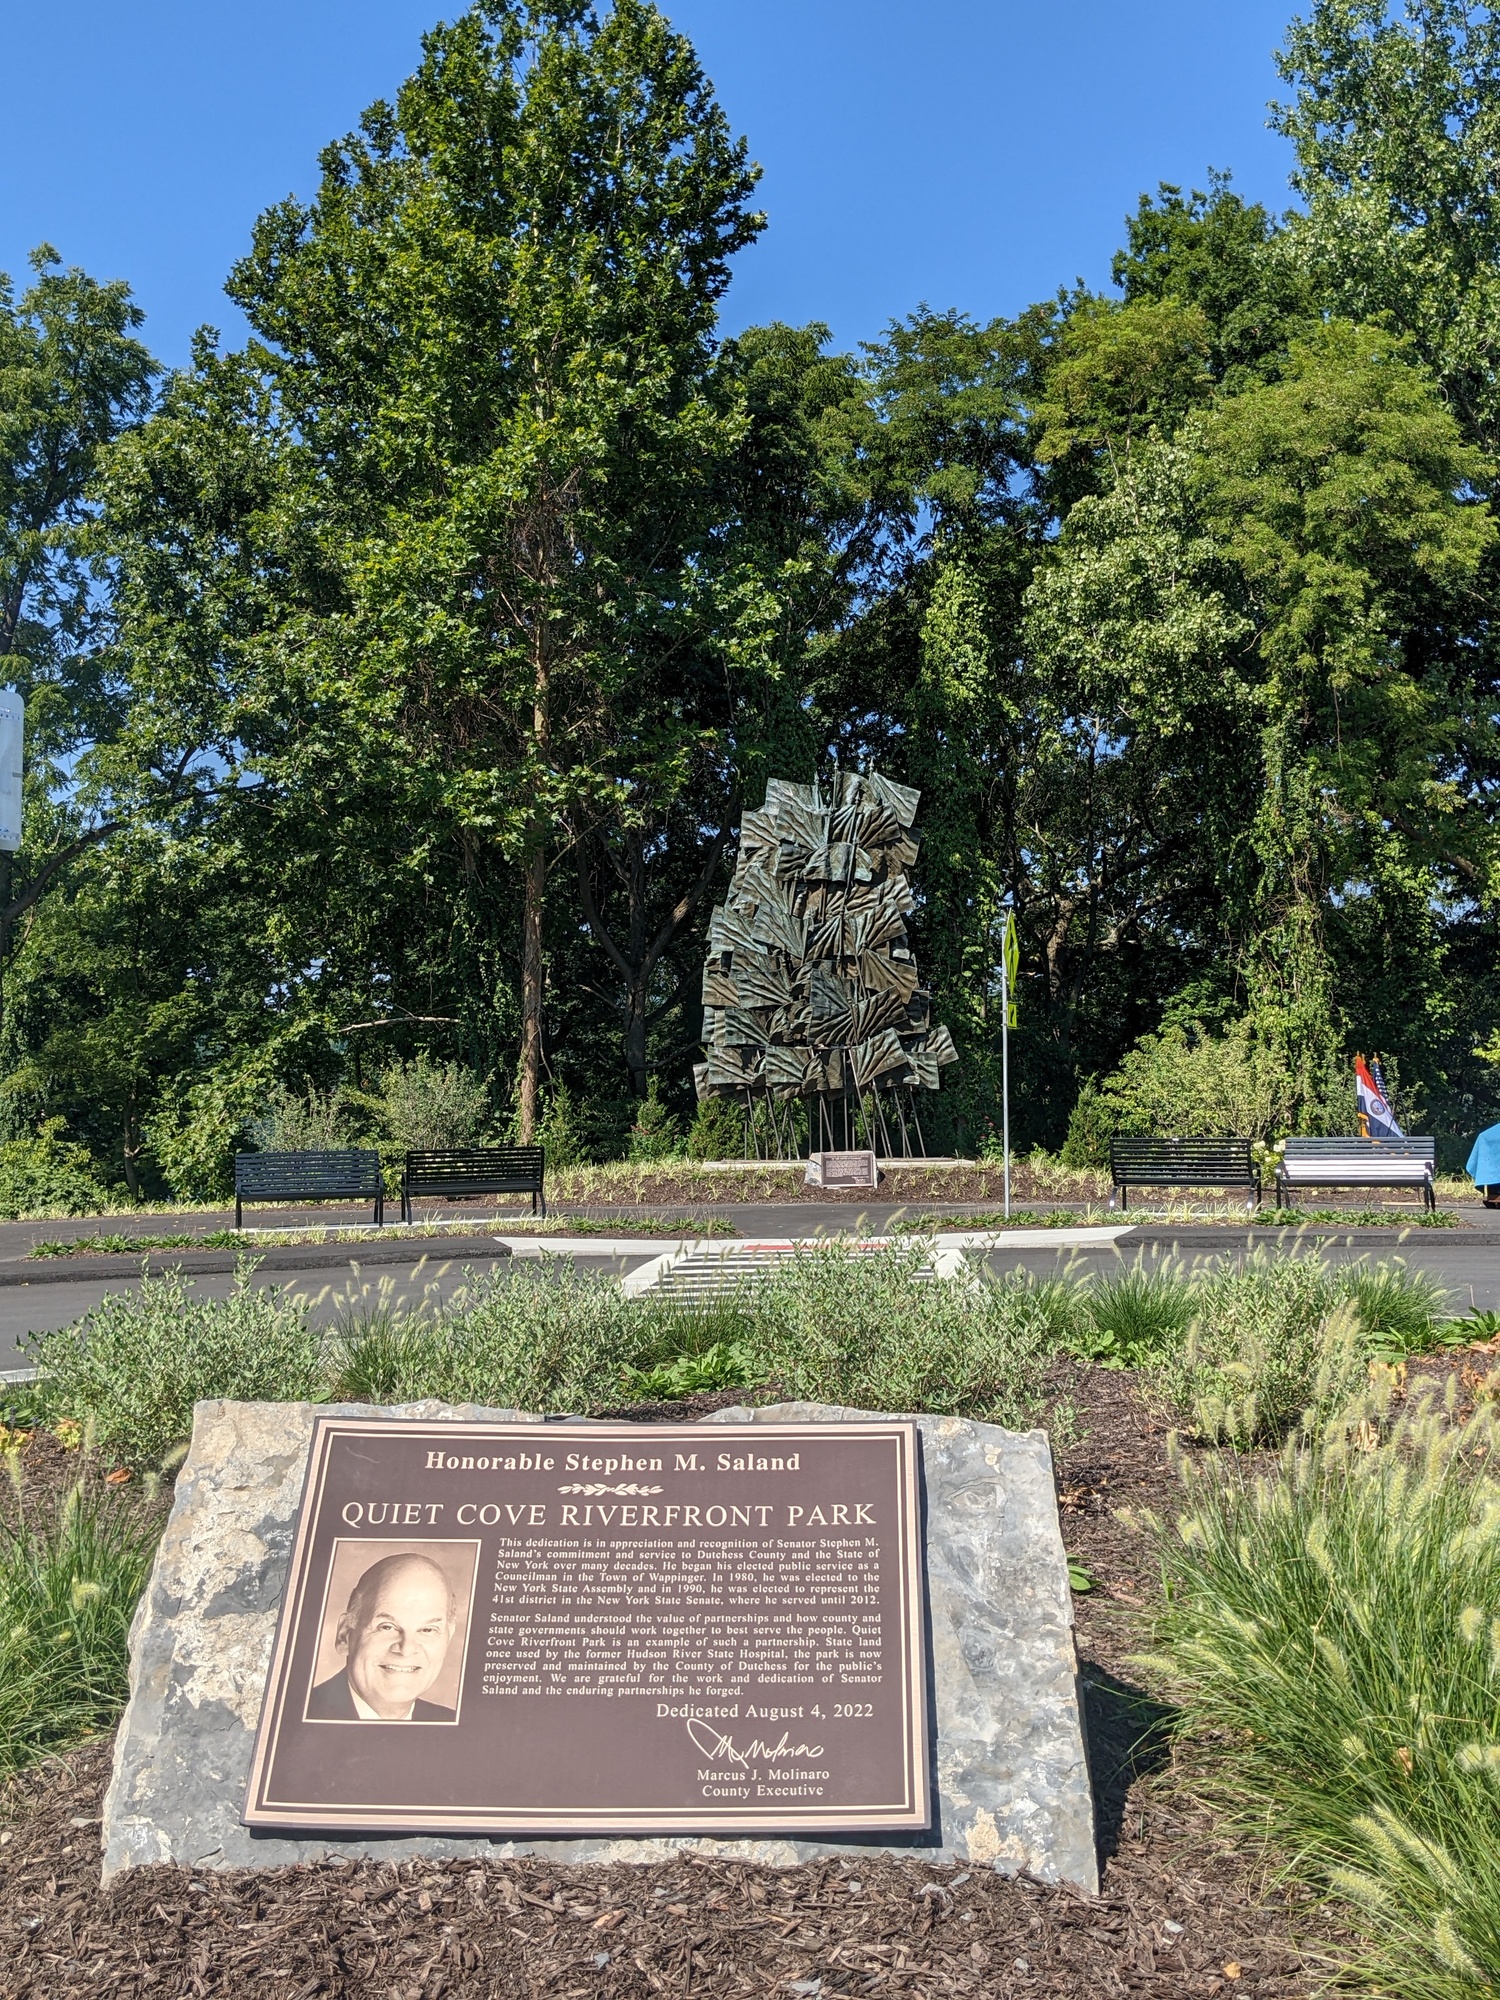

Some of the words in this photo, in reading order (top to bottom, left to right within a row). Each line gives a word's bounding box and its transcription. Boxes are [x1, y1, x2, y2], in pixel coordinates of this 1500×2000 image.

[424, 1451, 555, 1471] Honorable
[564, 1453, 663, 1476] Stephen
[673, 1453, 706, 1472] M.
[716, 1452, 801, 1471] Saland
[341, 1501, 444, 1529] QUIET
[456, 1503, 546, 1526] COVE
[559, 1504, 774, 1527] RIVERFRONT
[786, 1503, 877, 1527] PARK
[499, 1537, 522, 1547] This
[525, 1537, 579, 1548] dedication
[583, 1538, 592, 1548] is
[596, 1538, 606, 1548] in
[609, 1538, 674, 1550] appreciation
[677, 1538, 696, 1548] and
[699, 1538, 758, 1550] recognition
[761, 1538, 775, 1549] of
[776, 1539, 817, 1549] Senator
[819, 1538, 861, 1550] Stephen
[864, 1537, 879, 1547] M.
[546, 1549, 610, 1559] commitment
[615, 1549, 634, 1559] and
[639, 1549, 676, 1560] service
[681, 1551, 692, 1559] to
[697, 1549, 744, 1560] Dutchess
[748, 1550, 787, 1562] County
[791, 1550, 810, 1560] and
[815, 1549, 832, 1559] the
[836, 1549, 863, 1559] State
[868, 1548, 881, 1558] of
[496, 1559, 520, 1570] New
[524, 1560, 549, 1570] York
[553, 1562, 577, 1570] over
[581, 1562, 609, 1573] many
[613, 1560, 657, 1571] decades.
[662, 1561, 677, 1571] He
[681, 1561, 712, 1573] began
[716, 1561, 732, 1571] his
[736, 1561, 774, 1571] elected
[778, 1561, 811, 1573] public
[815, 1560, 853, 1571] service
[857, 1562, 869, 1570] as
[873, 1562, 880, 1570] a
[495, 1571, 557, 1581] Councilman
[562, 1571, 573, 1582] in
[578, 1572, 595, 1582] the
[599, 1572, 627, 1582] Town
[632, 1572, 646, 1582] of
[648, 1572, 707, 1584] Wappinger.
[712, 1572, 723, 1582] In
[729, 1572, 758, 1583] 1980,
[762, 1572, 775, 1582] he
[780, 1574, 800, 1582] was
[805, 1572, 843, 1582] elected
[847, 1573, 859, 1582] to
[863, 1572, 880, 1582] the
[494, 1582, 518, 1592] New
[522, 1583, 547, 1593] York
[551, 1583, 578, 1593] State
[582, 1583, 634, 1596] Assembly
[637, 1583, 657, 1594] and
[661, 1583, 672, 1593] in
[678, 1583, 706, 1594] 1990,
[710, 1583, 723, 1594] he
[752, 1583, 790, 1594] elected
[795, 1585, 806, 1593] to
[810, 1585, 859, 1595] represent
[863, 1583, 880, 1593] the
[492, 1594, 515, 1604] 41st
[518, 1594, 557, 1605] district
[561, 1595, 572, 1605] in
[576, 1595, 593, 1605] the
[597, 1595, 621, 1605] New
[625, 1595, 650, 1605] York
[654, 1595, 681, 1605] State
[685, 1595, 724, 1606] Senate,
[728, 1595, 761, 1605] where
[765, 1595, 778, 1605] he
[781, 1595, 817, 1605] served
[821, 1594, 846, 1605] until
[850, 1594, 880, 1605] 2012.
[490, 1612, 531, 1623] Senator
[534, 1613, 570, 1623] Saland
[574, 1613, 632, 1623] understood
[636, 1613, 653, 1623] the
[656, 1613, 685, 1623] value
[688, 1613, 702, 1623] of
[704, 1613, 769, 1625] partnerships
[773, 1613, 792, 1623] and
[796, 1613, 819, 1623] how
[822, 1614, 859, 1625] county
[862, 1613, 882, 1623] and
[488, 1625, 514, 1635] state
[518, 1626, 586, 1637] governments
[590, 1625, 626, 1635] should
[630, 1625, 657, 1635] work
[662, 1625, 707, 1637] together
[711, 1626, 722, 1635] to
[726, 1624, 748, 1635] best
[753, 1627, 782, 1635] serve
[786, 1624, 803, 1635] the
[807, 1624, 847, 1637] people.
[851, 1624, 882, 1636] Quiet
[487, 1636, 515, 1647] Cove
[520, 1636, 576, 1647] Riverfront
[582, 1637, 606, 1647] Park
[612, 1637, 622, 1647] is
[627, 1639, 640, 1647] an
[645, 1636, 690, 1649] example
[695, 1636, 709, 1647] of
[713, 1636, 737, 1647] such
[743, 1639, 749, 1647] a
[755, 1636, 819, 1649] partnership.
[825, 1636, 853, 1647] State
[858, 1636, 882, 1647] land
[485, 1650, 511, 1658] once
[516, 1648, 541, 1659] used
[545, 1648, 559, 1661] by
[564, 1649, 581, 1659] the
[585, 1648, 622, 1659] former
[626, 1649, 667, 1659] Hudson
[672, 1648, 703, 1659] River
[707, 1648, 734, 1659] State
[739, 1648, 788, 1661] Hospital,
[793, 1648, 811, 1659] the
[815, 1648, 840, 1661] park
[845, 1648, 855, 1659] is
[859, 1651, 882, 1659] now
[484, 1660, 537, 1672] preserved
[542, 1661, 562, 1671] and
[568, 1660, 627, 1671] maintained
[633, 1660, 647, 1673] by
[652, 1660, 670, 1671] the
[675, 1660, 715, 1673] County
[720, 1660, 734, 1671] of
[738, 1660, 787, 1671] Dutchess
[793, 1660, 810, 1671] for
[815, 1660, 833, 1671] the
[482, 1672, 542, 1685] enjoyment.
[550, 1673, 567, 1683] We
[574, 1675, 591, 1683] are
[597, 1672, 641, 1685] grateful
[648, 1672, 665, 1683] for
[672, 1673, 689, 1683] the
[696, 1673, 723, 1683] work
[730, 1673, 750, 1683] and
[757, 1673, 814, 1684] dedication
[821, 1673, 835, 1683] of
[840, 1673, 883, 1684] Senator
[481, 1684, 518, 1695] Saland
[521, 1685, 542, 1695] and
[545, 1685, 563, 1695] the
[566, 1685, 614, 1698] enduring
[617, 1685, 685, 1698] partnerships
[688, 1685, 702, 1696] he
[706, 1685, 744, 1698] forged.
[656, 1703, 739, 1718] Dedicated
[745, 1704, 804, 1722] August
[810, 1703, 826, 1720] 4,
[833, 1703, 874, 1718] 2022
[697, 1769, 746, 1781] Marcus
[750, 1769, 762, 1781] J.
[768, 1768, 830, 1781] Molinaro
[702, 1784, 751, 1800] County
[756, 1783, 824, 1797] Executive
